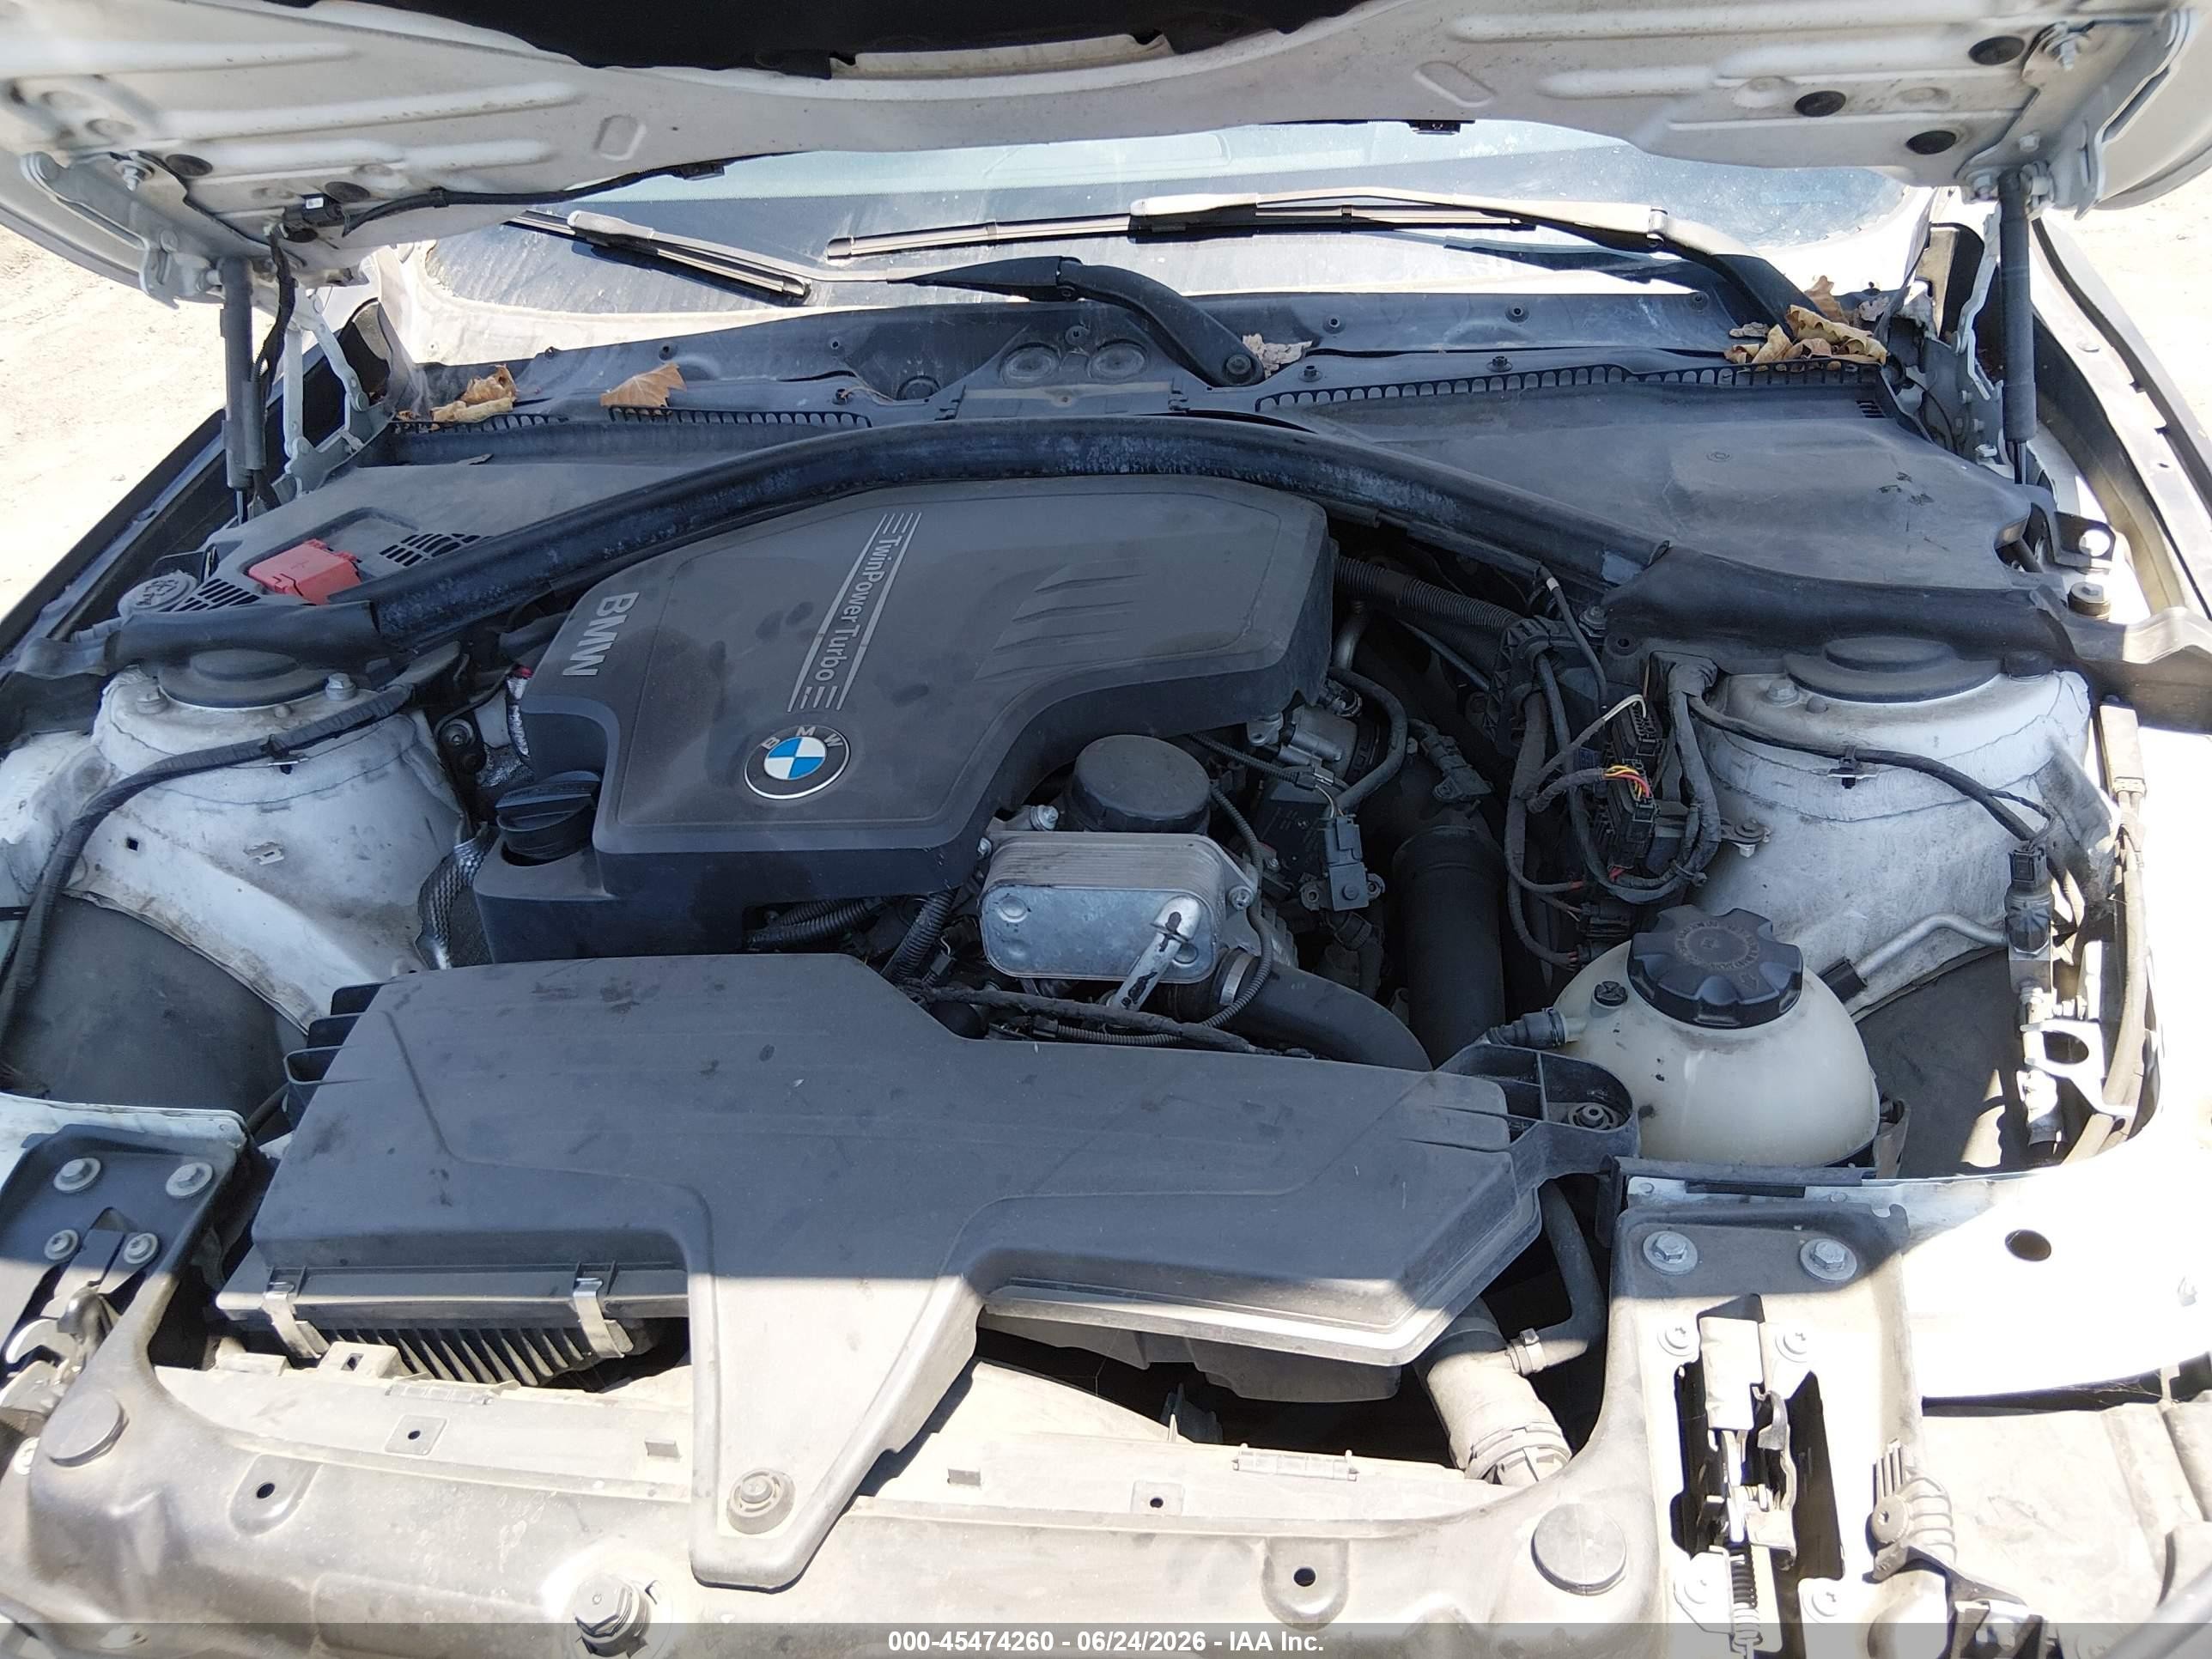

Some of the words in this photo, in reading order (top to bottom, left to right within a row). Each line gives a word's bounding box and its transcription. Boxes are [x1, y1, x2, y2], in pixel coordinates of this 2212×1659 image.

[841, 536, 902, 623] TwinPower
[562, 592, 640, 677] BMW
[815, 624, 860, 681] Turbo
[761, 726, 843, 750] BMW
